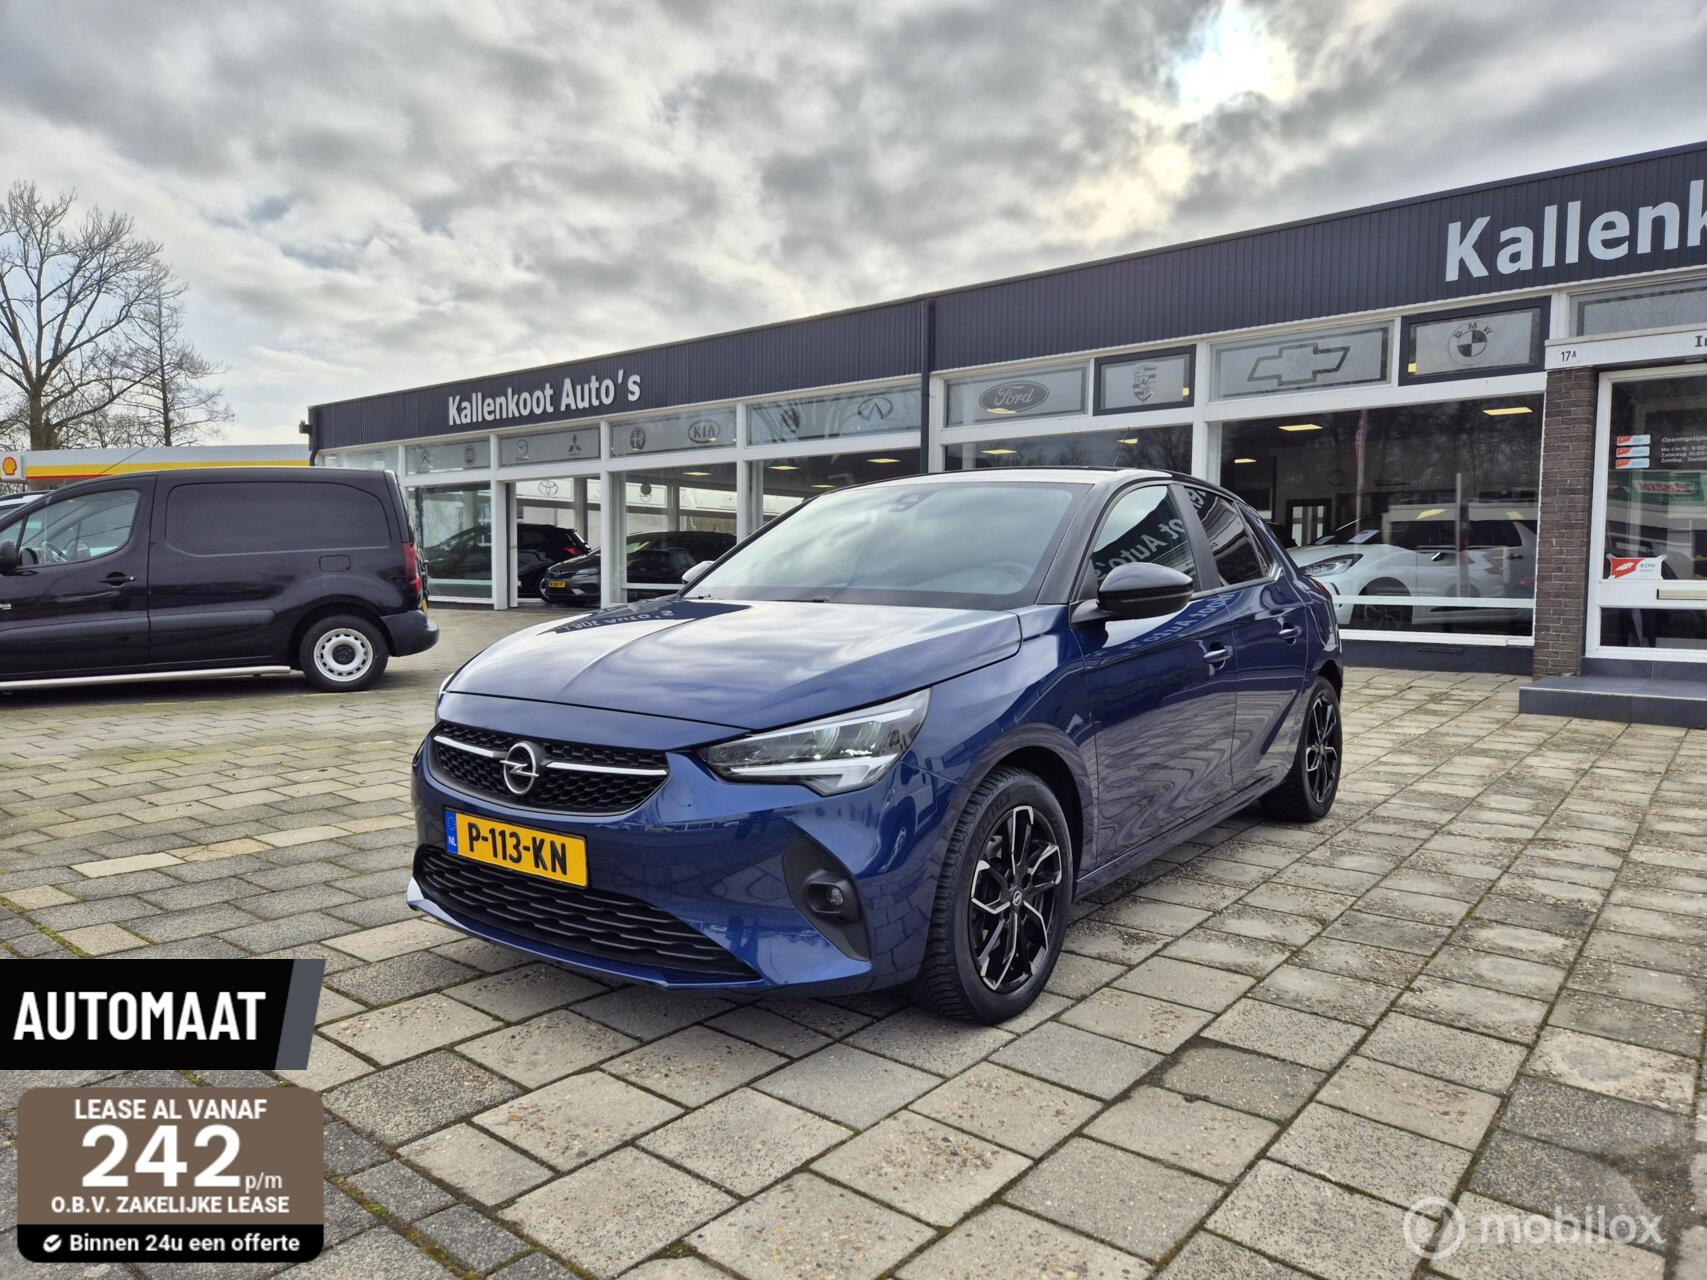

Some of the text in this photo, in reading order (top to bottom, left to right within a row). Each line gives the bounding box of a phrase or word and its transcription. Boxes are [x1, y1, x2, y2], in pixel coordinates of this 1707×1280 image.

[448, 369, 641, 426] Kallenkoot Auto's
[993, 385, 1034, 406] Ford
[693, 424, 716, 438] KIA
[467, 822, 568, 875] P-113-KN
